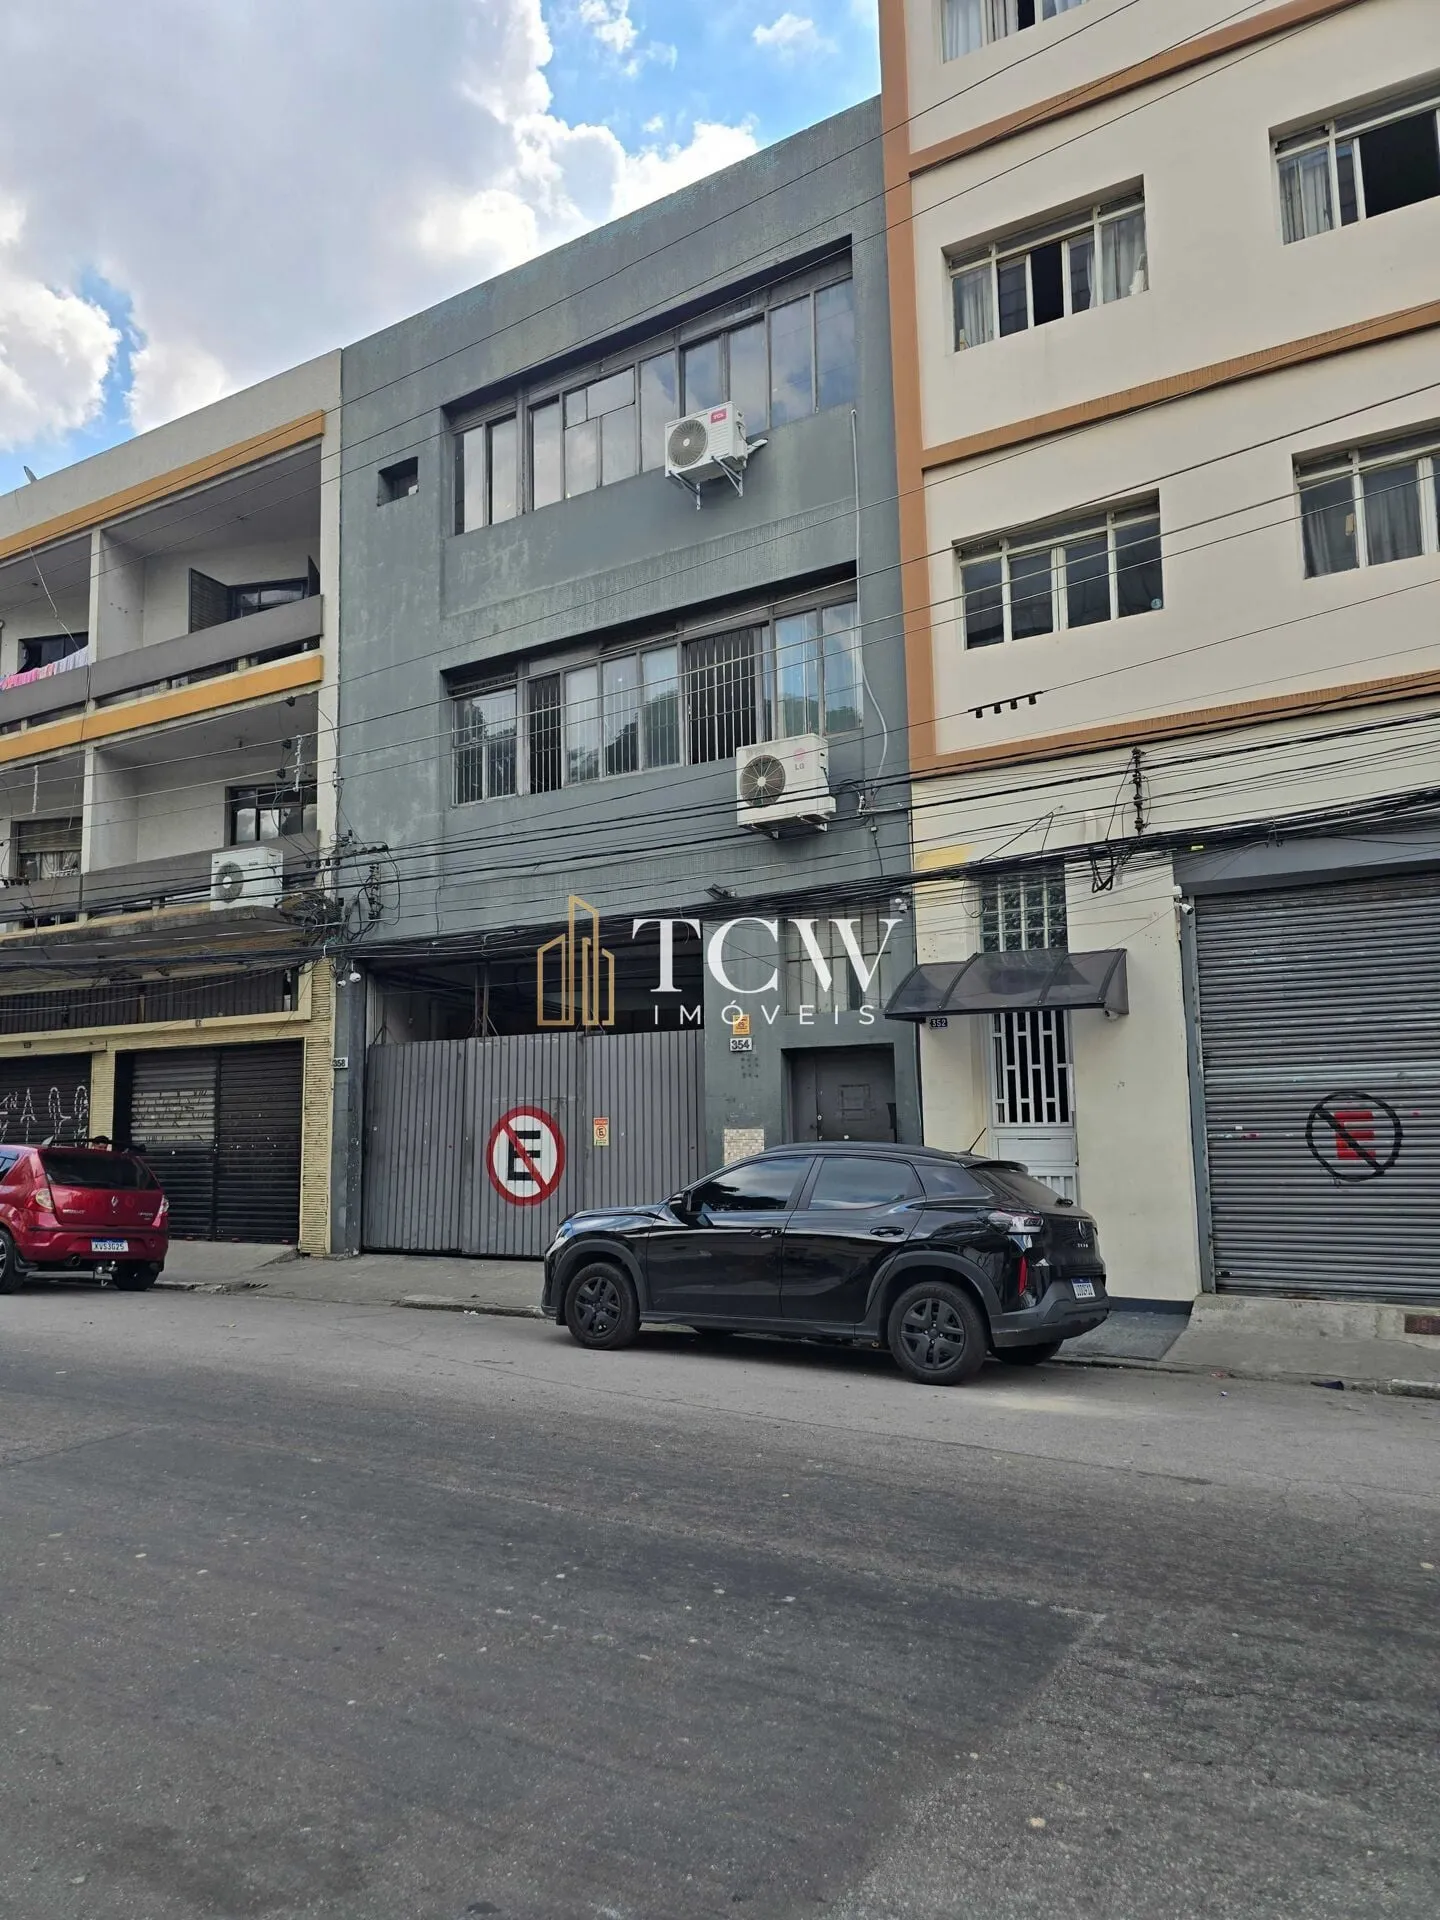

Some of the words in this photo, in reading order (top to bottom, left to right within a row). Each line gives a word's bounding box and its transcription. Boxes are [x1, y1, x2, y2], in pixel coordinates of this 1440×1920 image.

[795, 763, 805, 771] LG
[931, 1018, 947, 1027] 352
[730, 1039, 751, 1050] 354
[1334, 1110, 1377, 1160] E
[507, 1130, 541, 1181] E
